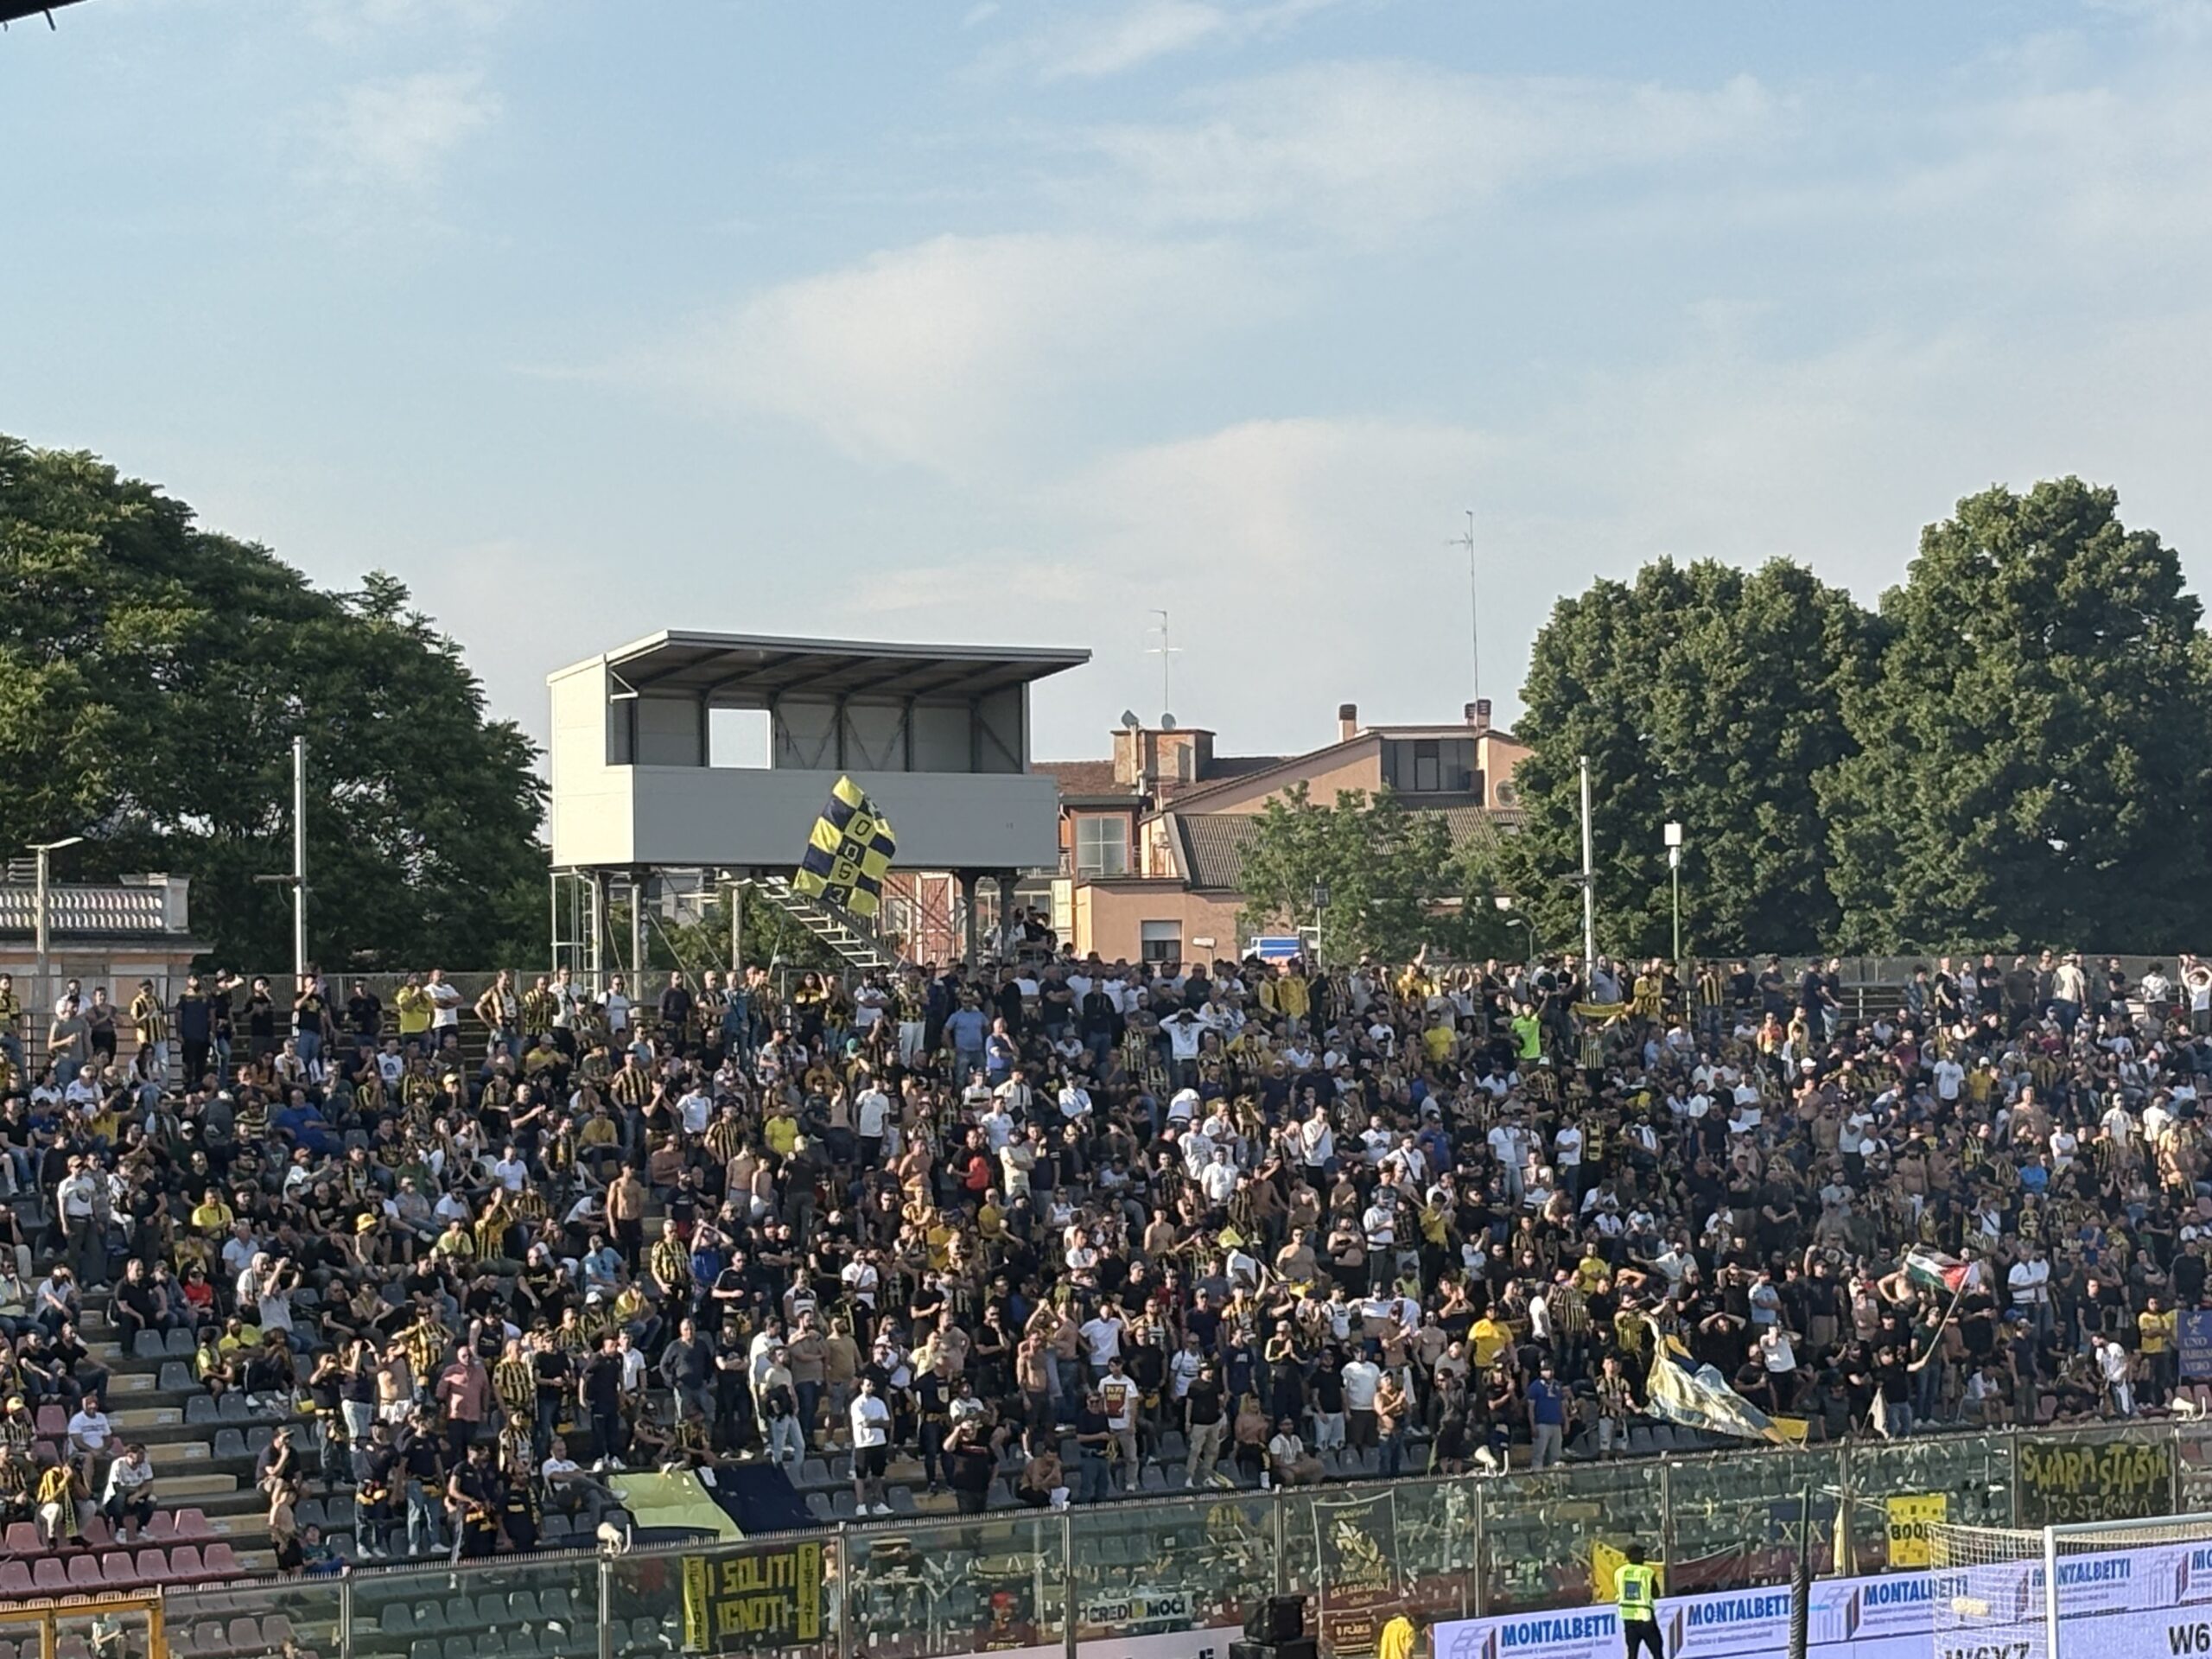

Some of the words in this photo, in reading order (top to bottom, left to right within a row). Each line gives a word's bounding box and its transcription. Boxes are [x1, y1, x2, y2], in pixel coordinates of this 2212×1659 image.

[2183, 1336, 2208, 1348] UNO
[707, 1563, 715, 1597] I
[722, 1554, 796, 1594] SOLITI
[716, 1595, 789, 1636] IGNOTI
[1687, 1594, 1791, 1627] MONTALBETT
[1501, 1613, 1616, 1647] MONTALBETTI
[2168, 1624, 2212, 1656] W6
